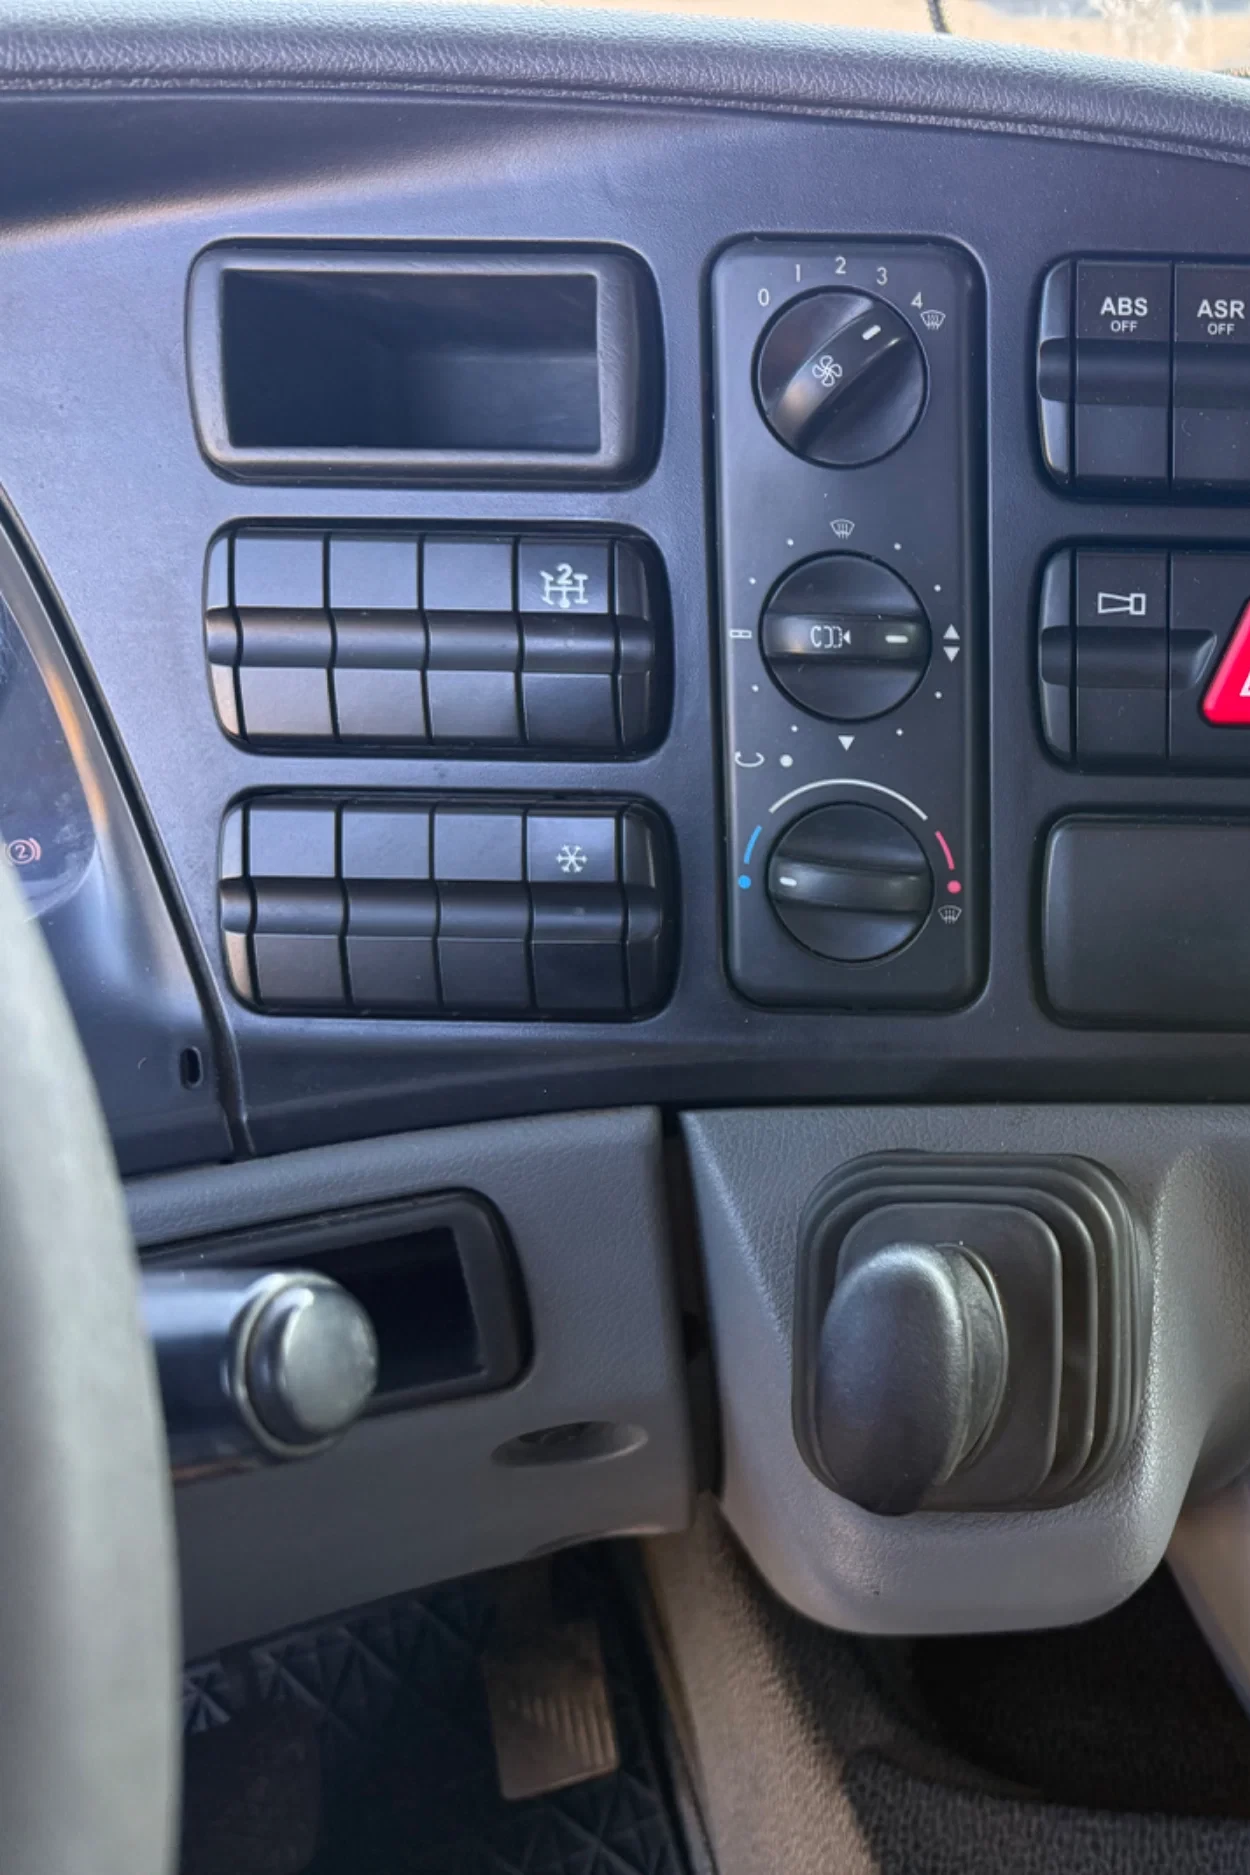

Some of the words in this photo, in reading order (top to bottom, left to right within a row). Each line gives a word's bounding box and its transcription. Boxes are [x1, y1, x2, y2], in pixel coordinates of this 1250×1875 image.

[757, 287, 770, 307] 0
[795, 263, 801, 283] 1
[834, 256, 847, 275] 2
[876, 266, 888, 285] 3
[910, 291, 923, 309] 4
[1099, 296, 1149, 317] ABS
[1196, 299, 1246, 320] ASR
[1110, 319, 1139, 333] OFF
[1206, 322, 1236, 336] OFF
[15, 844, 29, 859] 2
